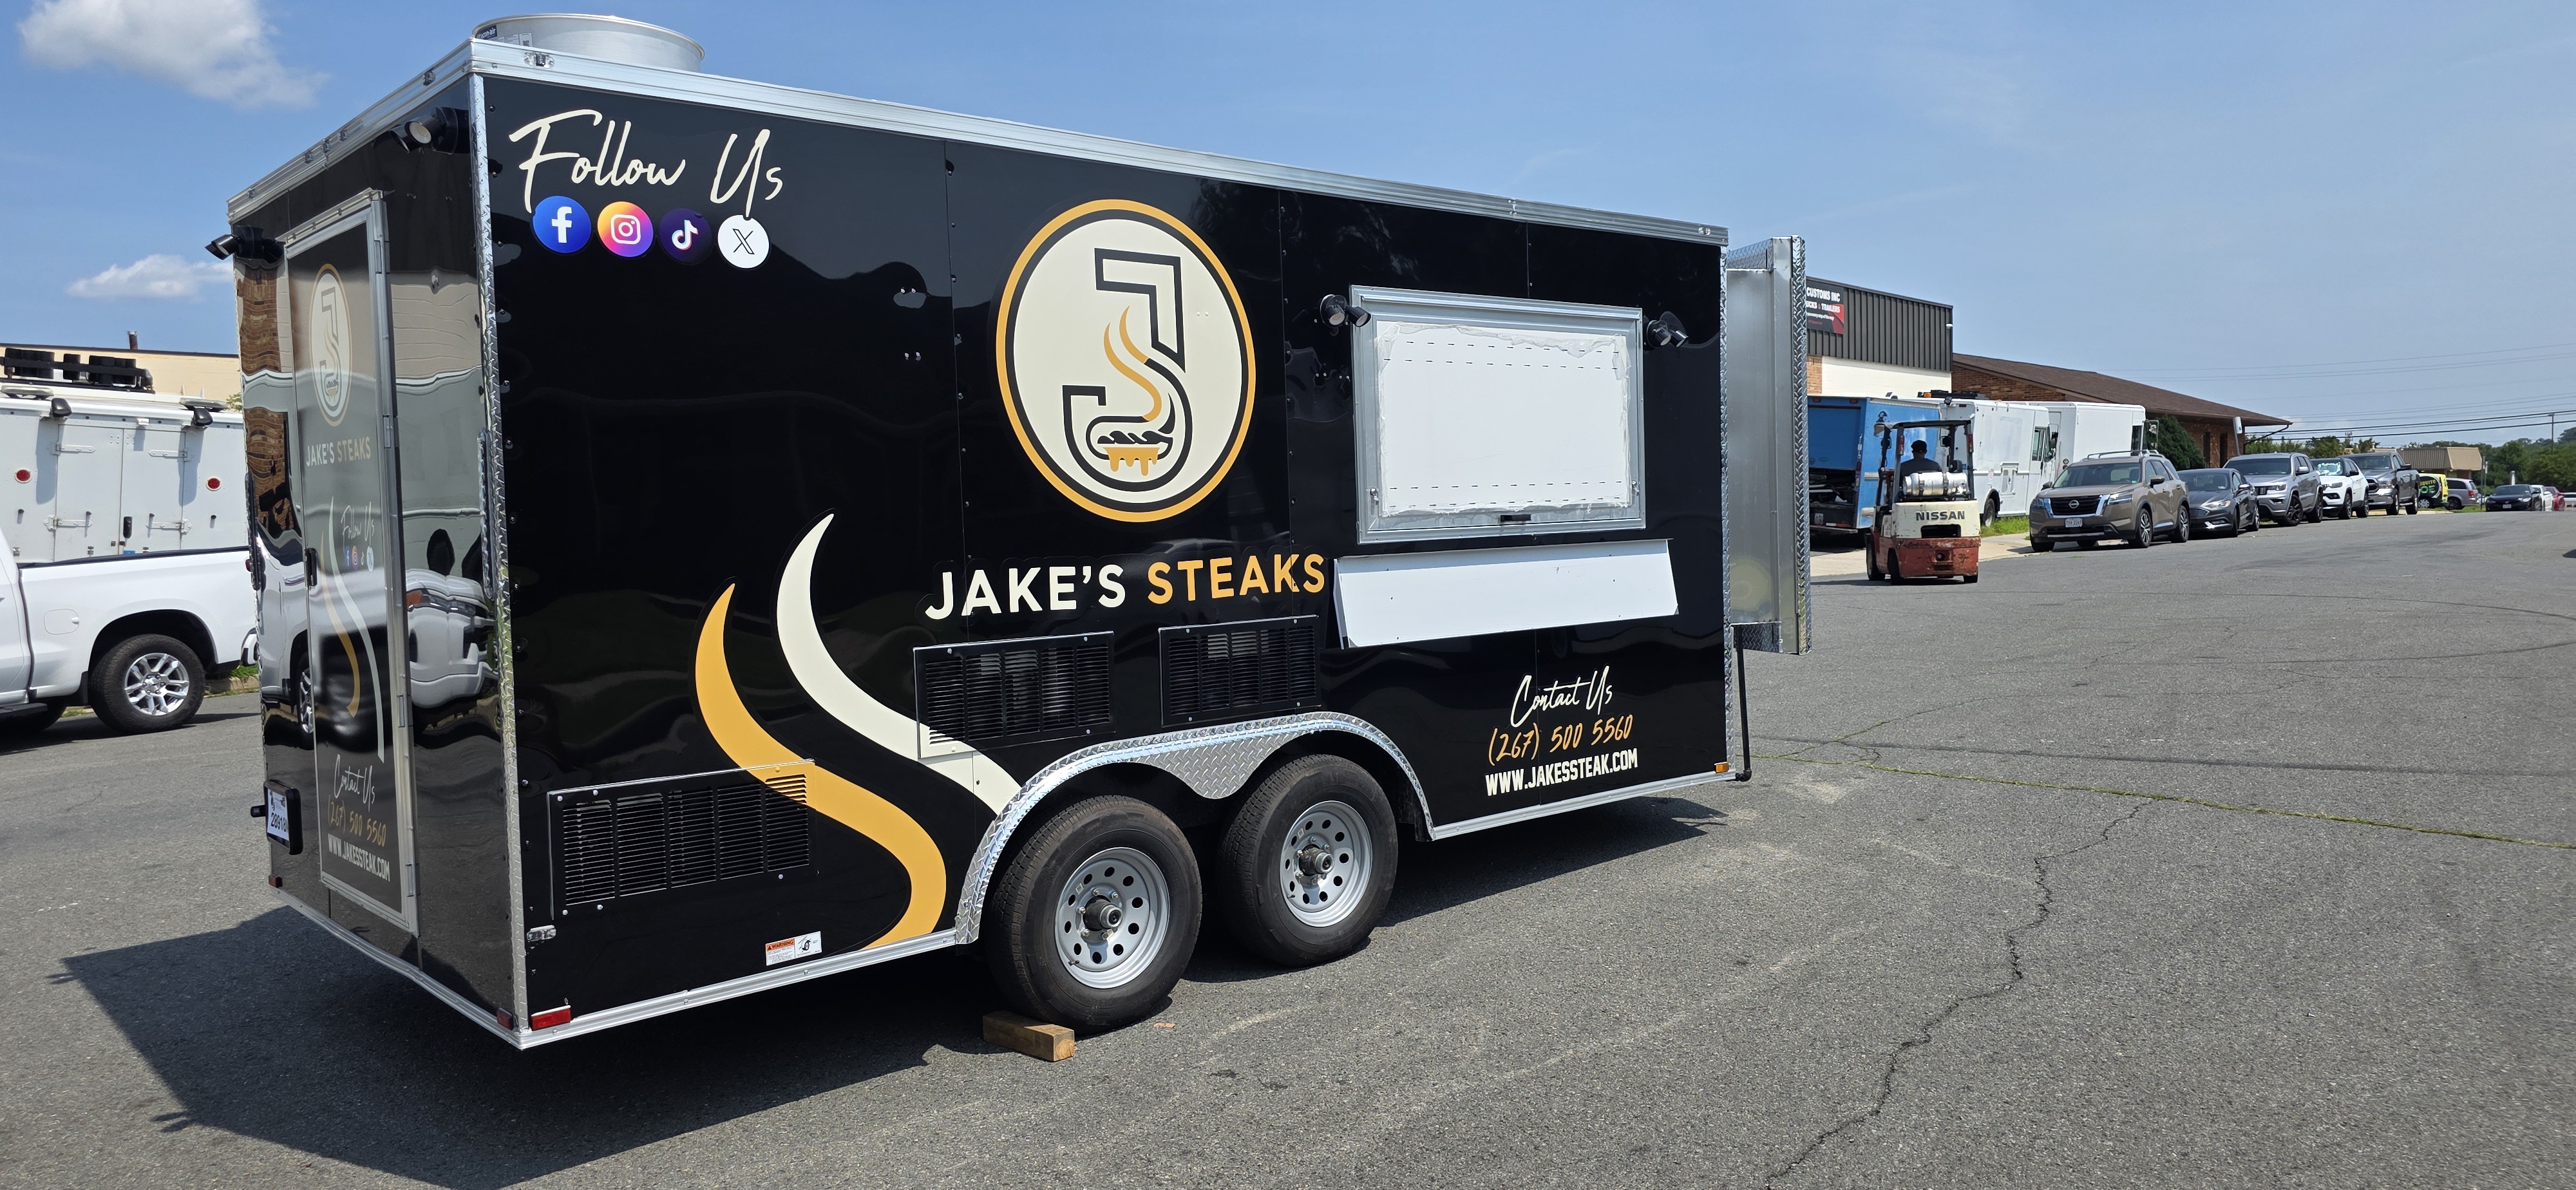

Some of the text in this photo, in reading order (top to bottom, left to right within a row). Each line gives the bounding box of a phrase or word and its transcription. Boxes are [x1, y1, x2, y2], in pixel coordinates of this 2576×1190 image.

[509, 109, 784, 218] Follow Us
[1806, 287, 1841, 302] CUSTOMS INC
[1821, 303, 1841, 313] TRAILERS
[306, 437, 371, 467] JAKE'S STEAKS
[2420, 485, 2435, 493] OE
[341, 502, 374, 554] Follow Us
[1916, 511, 1965, 521] NISSAN
[925, 553, 1325, 619] JAKE'S STEAKS
[1510, 666, 1613, 728] Contact Us
[1488, 714, 1633, 766] (267) 500 5560
[334, 753, 375, 812] Contact Us
[1485, 748, 1638, 796] WWW.JAKESSTEAK.COM
[328, 794, 386, 847] (267) 500 5560
[328, 833, 391, 882] WWW.JAKESSTEAK.COM
[772, 940, 794, 949] WARNING
